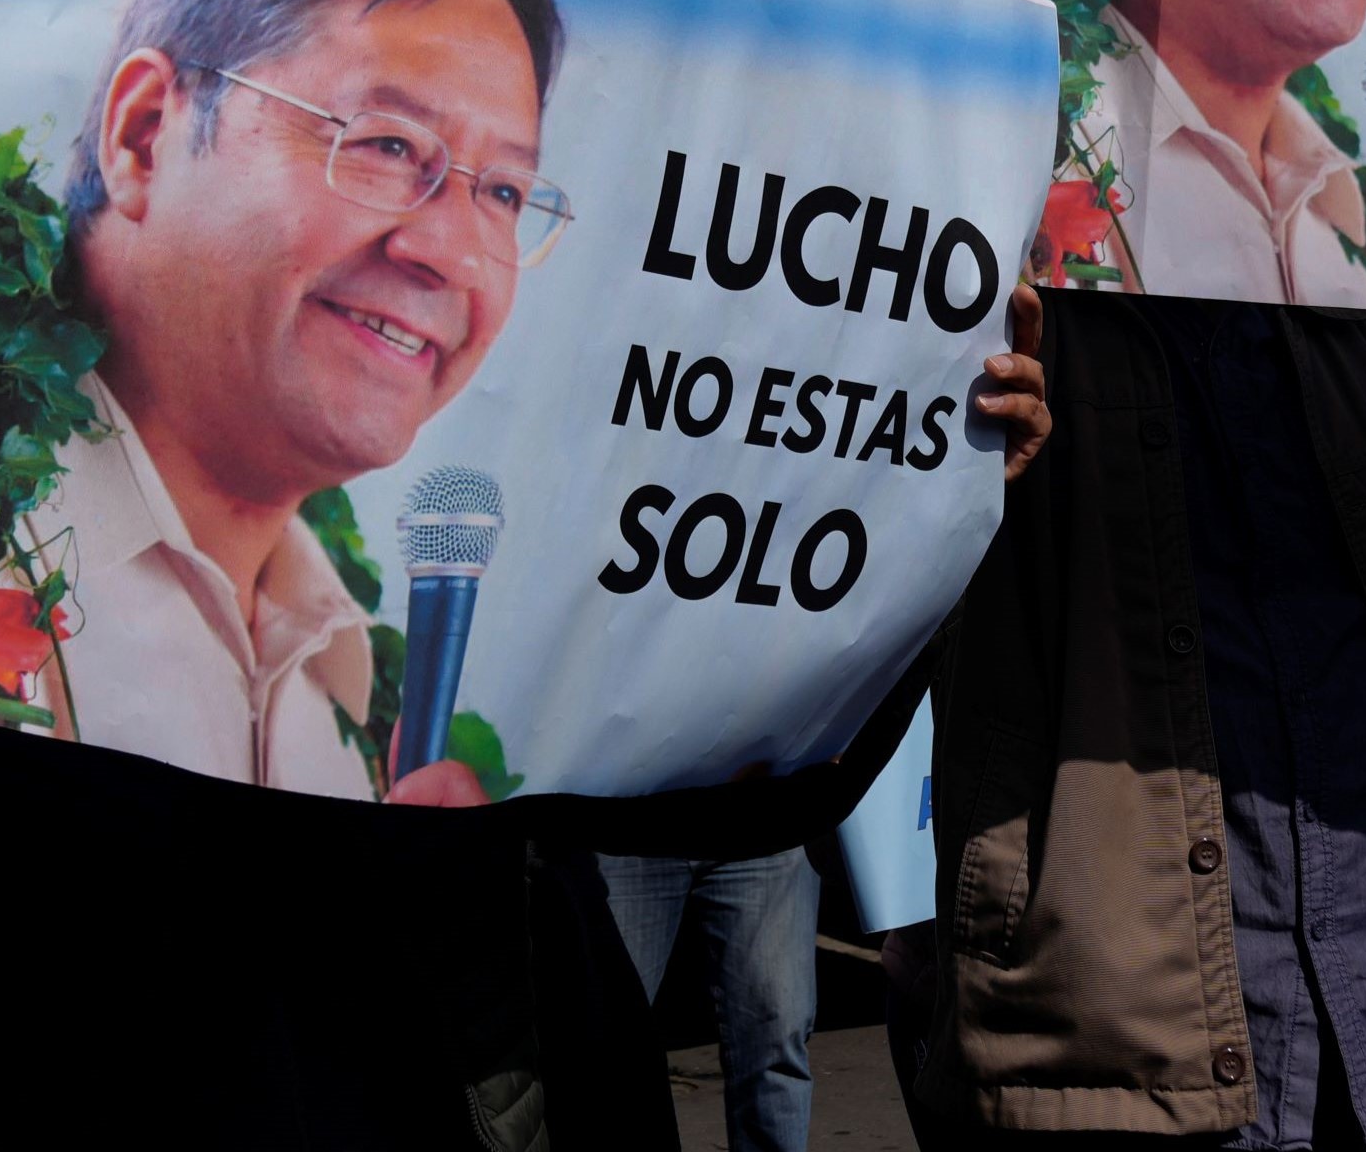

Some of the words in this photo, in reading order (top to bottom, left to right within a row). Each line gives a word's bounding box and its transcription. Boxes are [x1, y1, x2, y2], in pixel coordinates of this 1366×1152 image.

[641, 149, 1000, 334] LUCHO
[610, 343, 734, 438] NO
[743, 366, 958, 472] ESTAS
[597, 484, 868, 613] SOLO
